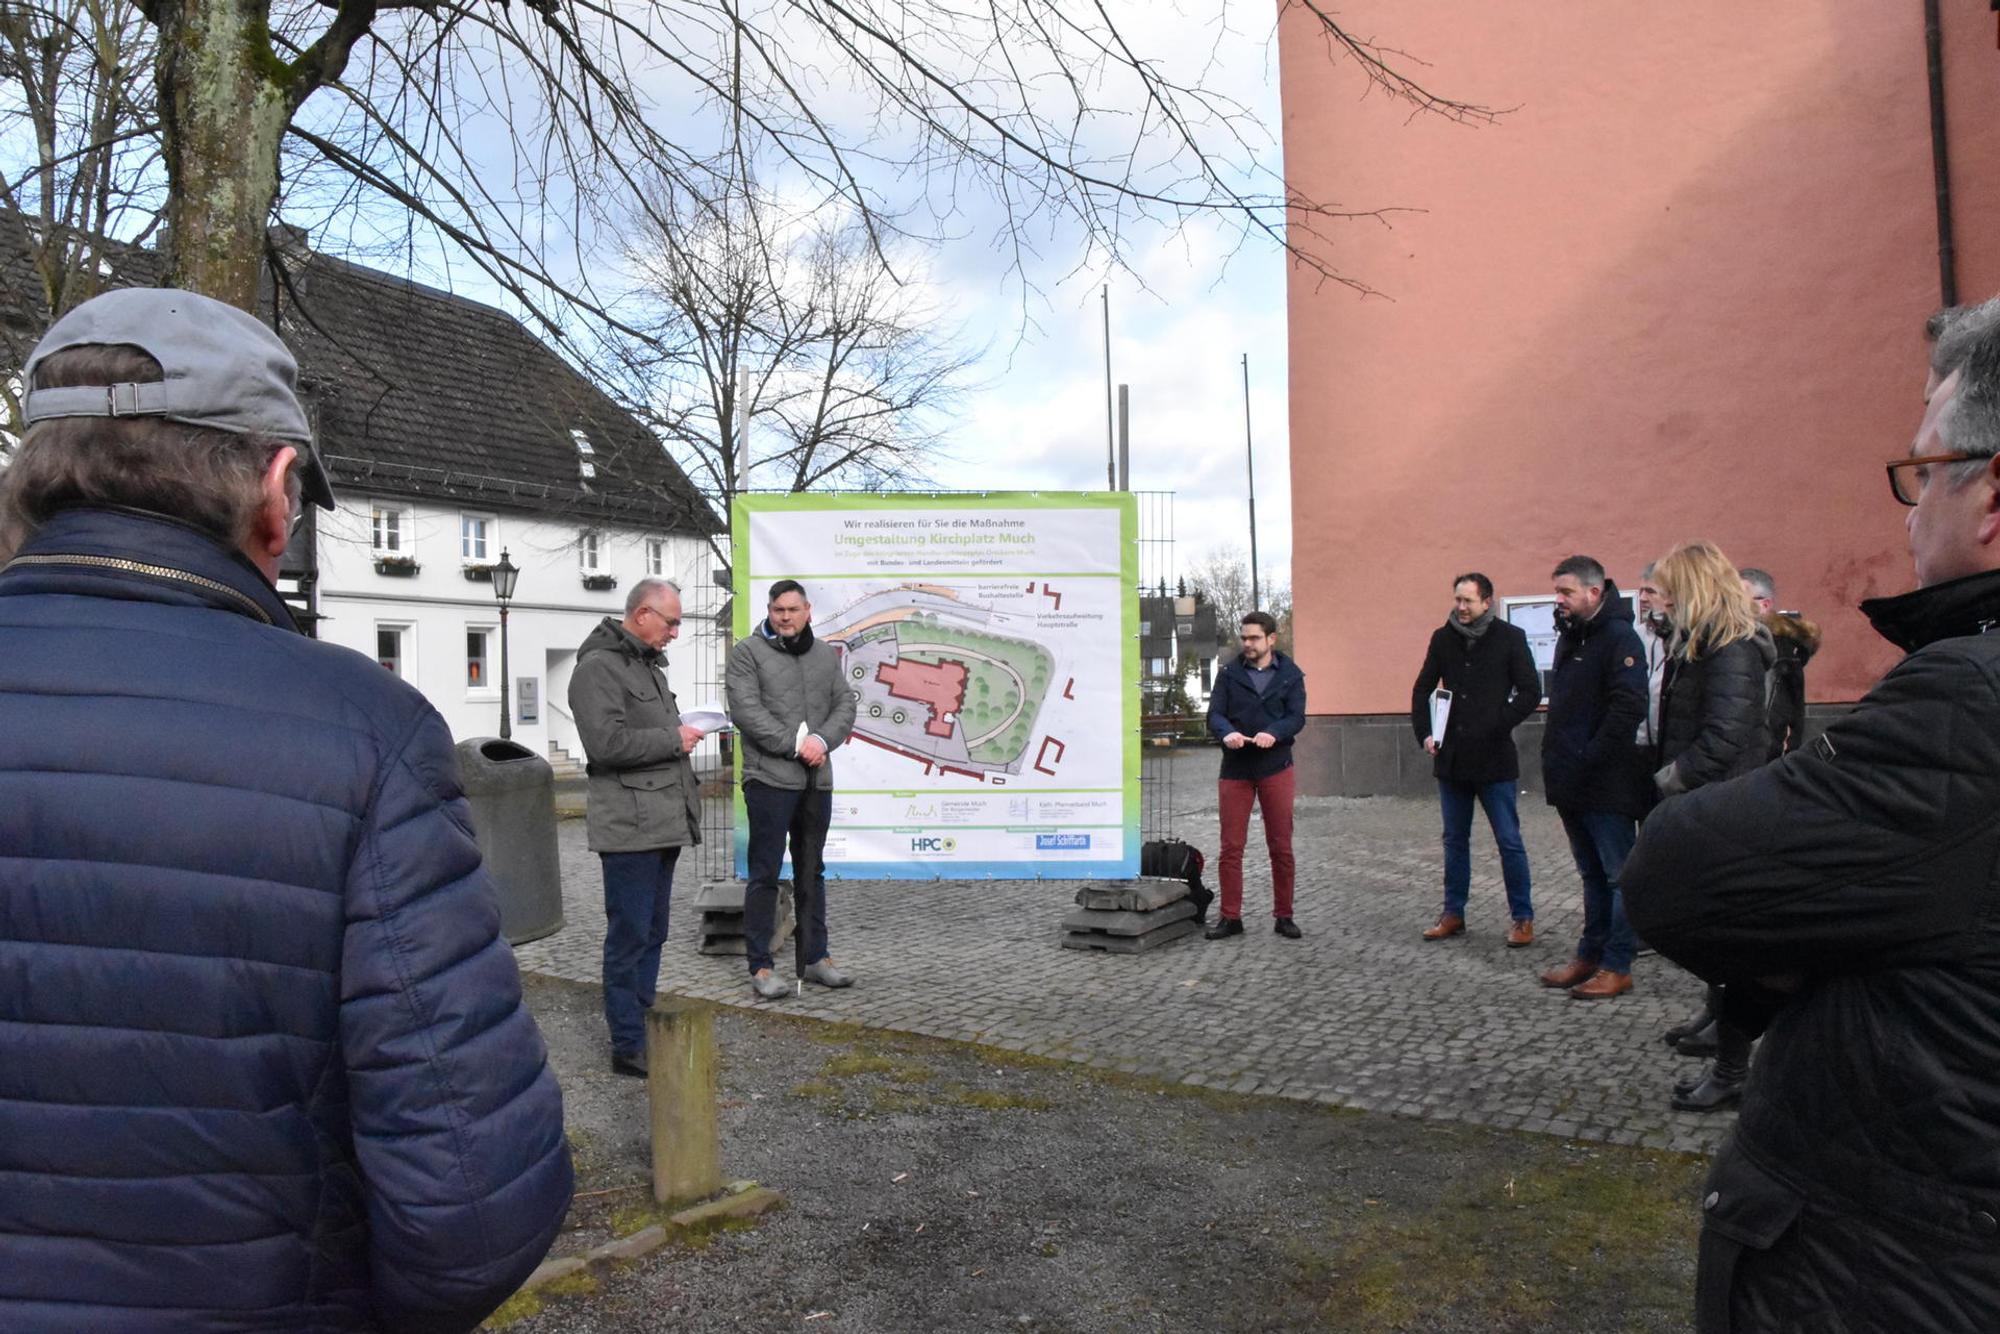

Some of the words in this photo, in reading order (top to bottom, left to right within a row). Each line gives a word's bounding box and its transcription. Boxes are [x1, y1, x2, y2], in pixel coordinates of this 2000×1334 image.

[844, 520, 861, 528] Wir
[864, 519, 914, 528] realisieren
[918, 519, 932, 528] für
[934, 519, 949, 528] Sie
[952, 519, 967, 528] die
[970, 518, 1025, 528] Maßnahme
[834, 533, 926, 547] Umgestaltung
[930, 532, 994, 546] Kirchplatz
[998, 532, 1036, 543] Much
[971, 559, 1003, 567] gefördert
[911, 837, 941, 852] HPC
